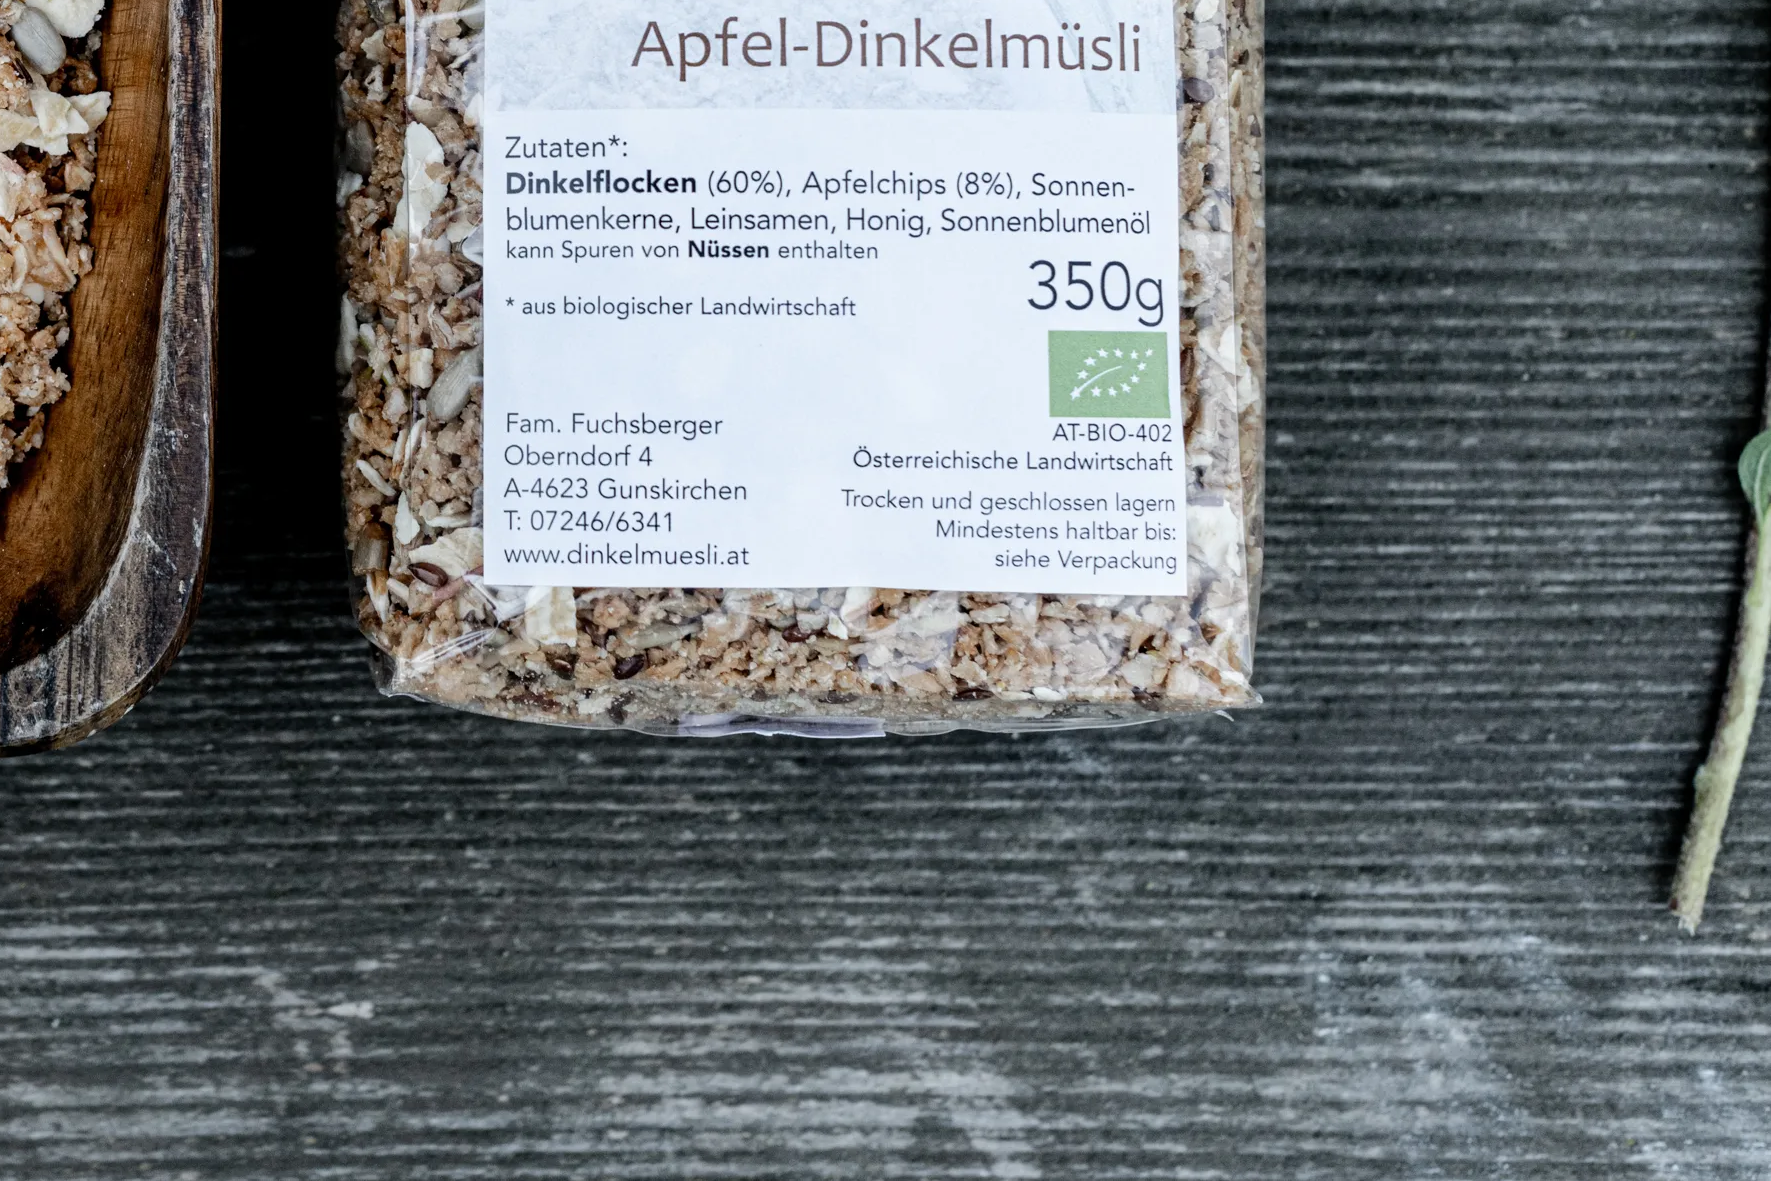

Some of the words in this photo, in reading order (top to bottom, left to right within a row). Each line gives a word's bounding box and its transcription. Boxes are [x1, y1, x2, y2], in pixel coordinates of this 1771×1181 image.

[631, 16, 1140, 82] Apfel-Dinkelmüsli
[507, 169, 696, 194] Dinkelflocken
[708, 171, 790, 200] (60%),
[802, 170, 946, 201] Apfelchips
[957, 172, 1020, 201] (8%),
[1032, 173, 1134, 197] Sonnen-
[507, 206, 680, 235] blumenkerne,
[692, 207, 835, 236] Leinsamen,
[847, 208, 931, 238] Honig,
[941, 208, 1150, 234] Sonnenblumenöl
[507, 240, 553, 258] kann
[562, 240, 633, 263] Spuren
[642, 245, 679, 258] von
[689, 240, 769, 258] Nüssen
[778, 240, 878, 259] enthalten
[1028, 260, 1163, 327] 350g
[523, 302, 556, 314] aus
[564, 296, 693, 320] biologischer
[702, 296, 856, 316] Landwirtschaft
[507, 413, 560, 433] Fam.
[573, 412, 723, 440] Fuchsberger
[1053, 423, 1172, 442] AT-BIO-402
[504, 444, 631, 466] Oberndorf
[639, 446, 652, 466] 4
[853, 446, 1018, 469] Österreichische
[1027, 451, 1173, 471] Landwirtschaft
[504, 478, 588, 498] A-4623
[598, 478, 746, 500] Gunskirchen
[841, 489, 923, 508] Trocken
[932, 491, 971, 509] und
[980, 492, 1107, 515] geschlossen
[1116, 492, 1175, 517] lagern
[504, 510, 520, 530] T:
[531, 510, 671, 532] 07246/6341
[937, 520, 1058, 539] Mindestens
[1067, 520, 1138, 540] haltbar
[1145, 522, 1175, 540] bis:
[504, 543, 749, 565] www.dinkelmuesli.at
[995, 549, 1050, 567] siehe
[1058, 550, 1176, 575] Verpackung
